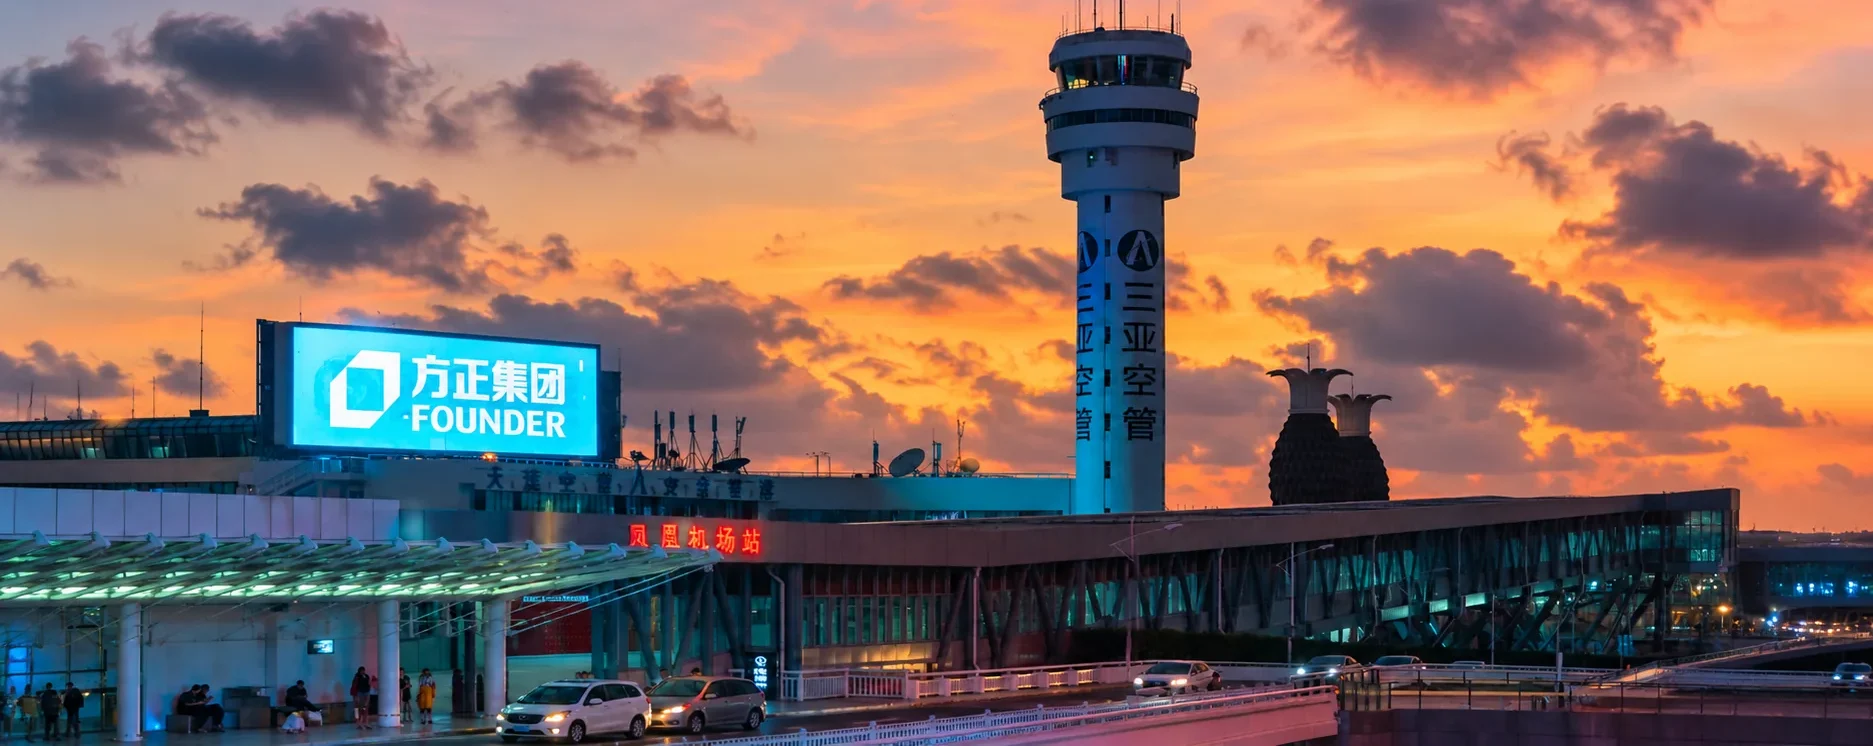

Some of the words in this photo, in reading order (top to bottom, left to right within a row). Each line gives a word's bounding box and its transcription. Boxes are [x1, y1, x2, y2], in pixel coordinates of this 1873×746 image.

[411, 354, 565, 404] 方正集团
[1122, 282, 1156, 440] 三亚空管
[411, 405, 566, 438] FOUNDER
[630, 524, 761, 555] 凤凰机场站
